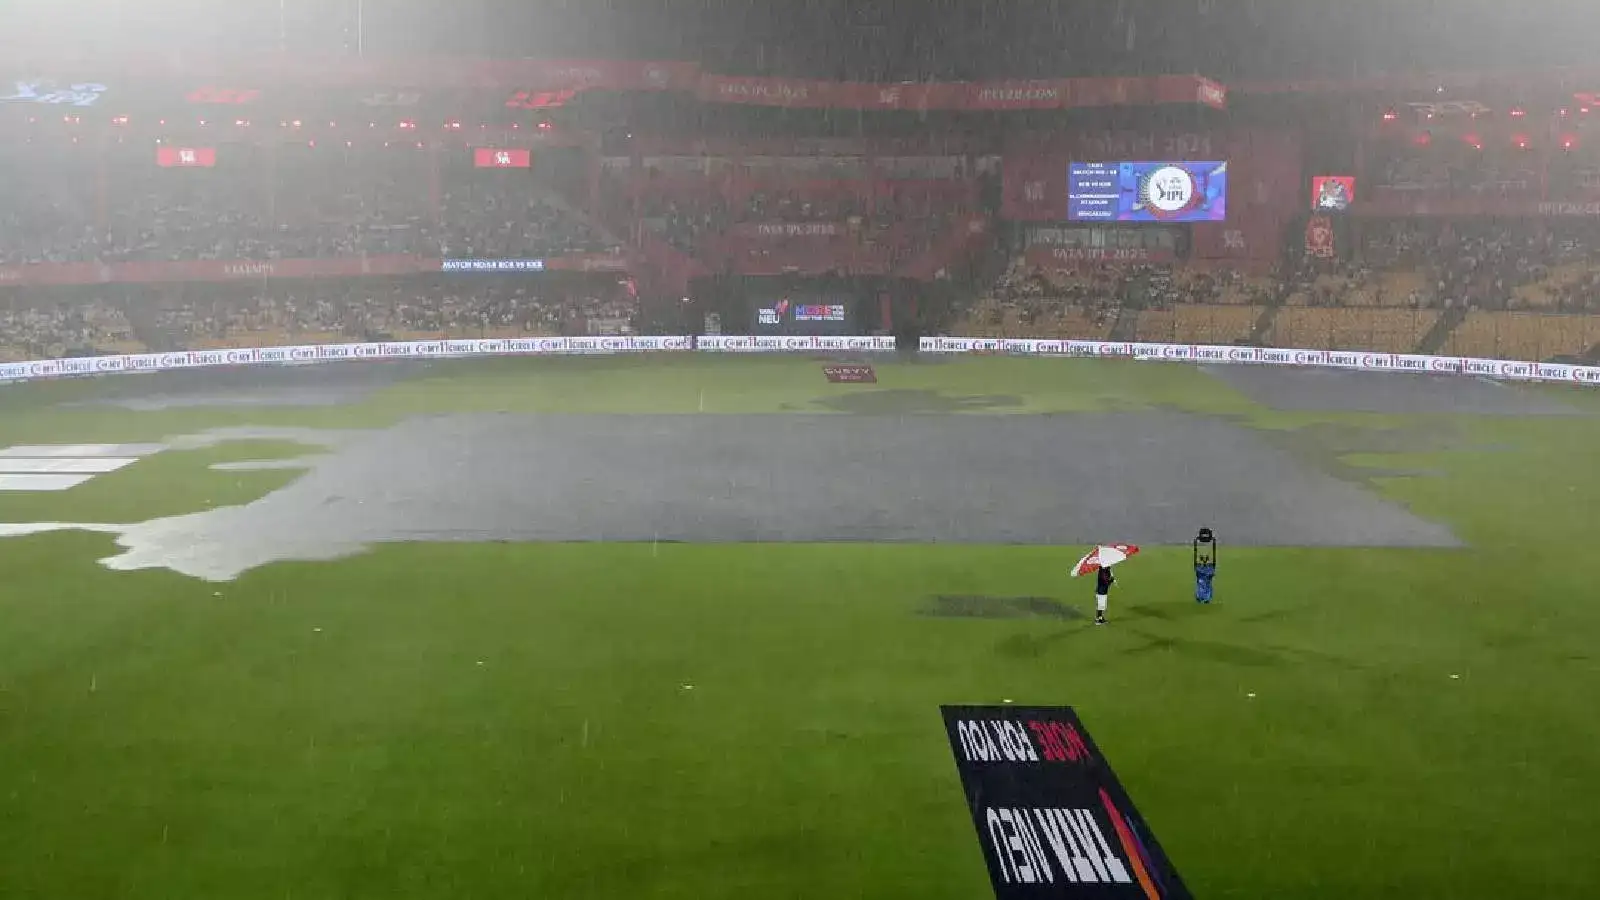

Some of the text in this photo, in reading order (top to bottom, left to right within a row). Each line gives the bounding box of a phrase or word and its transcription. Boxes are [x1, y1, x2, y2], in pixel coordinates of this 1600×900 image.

[759, 314, 780, 324] NEU
[957, 720, 1092, 761] MORE FOR YOU
[986, 806, 1133, 884] TATA NEU
